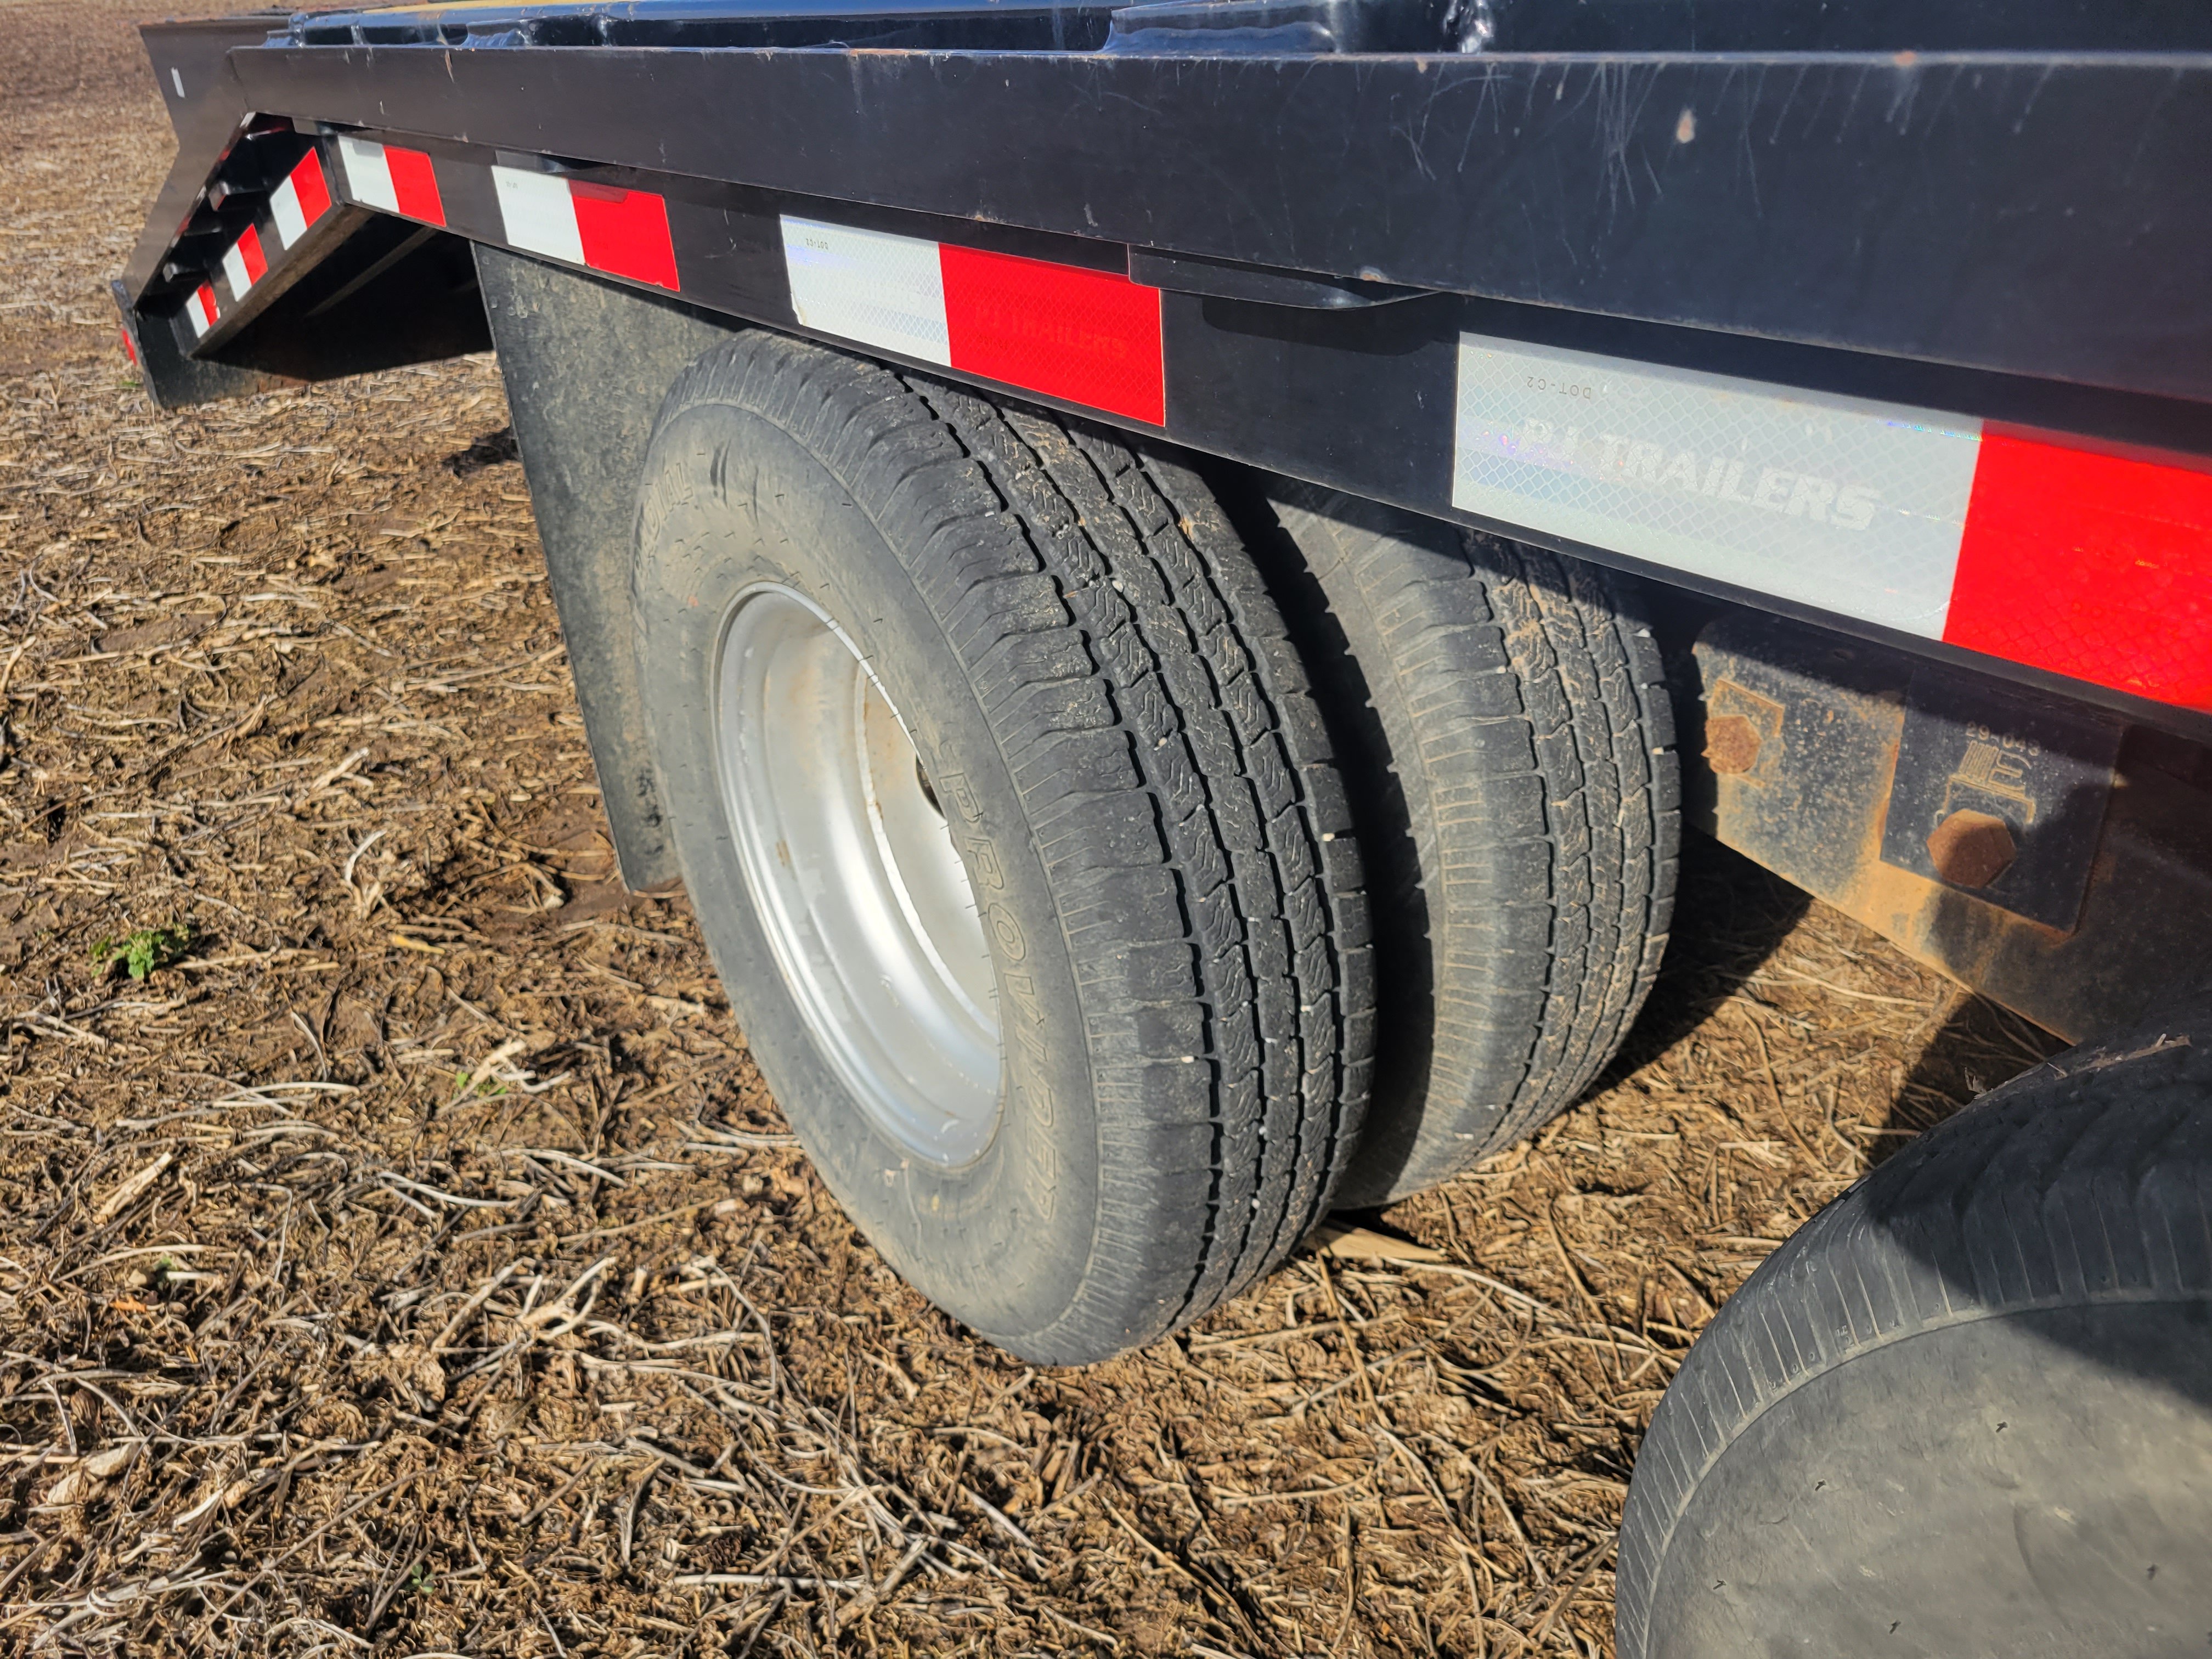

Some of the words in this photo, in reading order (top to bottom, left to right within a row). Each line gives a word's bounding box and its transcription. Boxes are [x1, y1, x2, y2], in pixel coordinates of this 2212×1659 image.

[1527, 376, 1592, 399] DOT-C2
[1599, 432, 1882, 531] TRAILERS
[939, 772, 1057, 1221] PROVIDER
